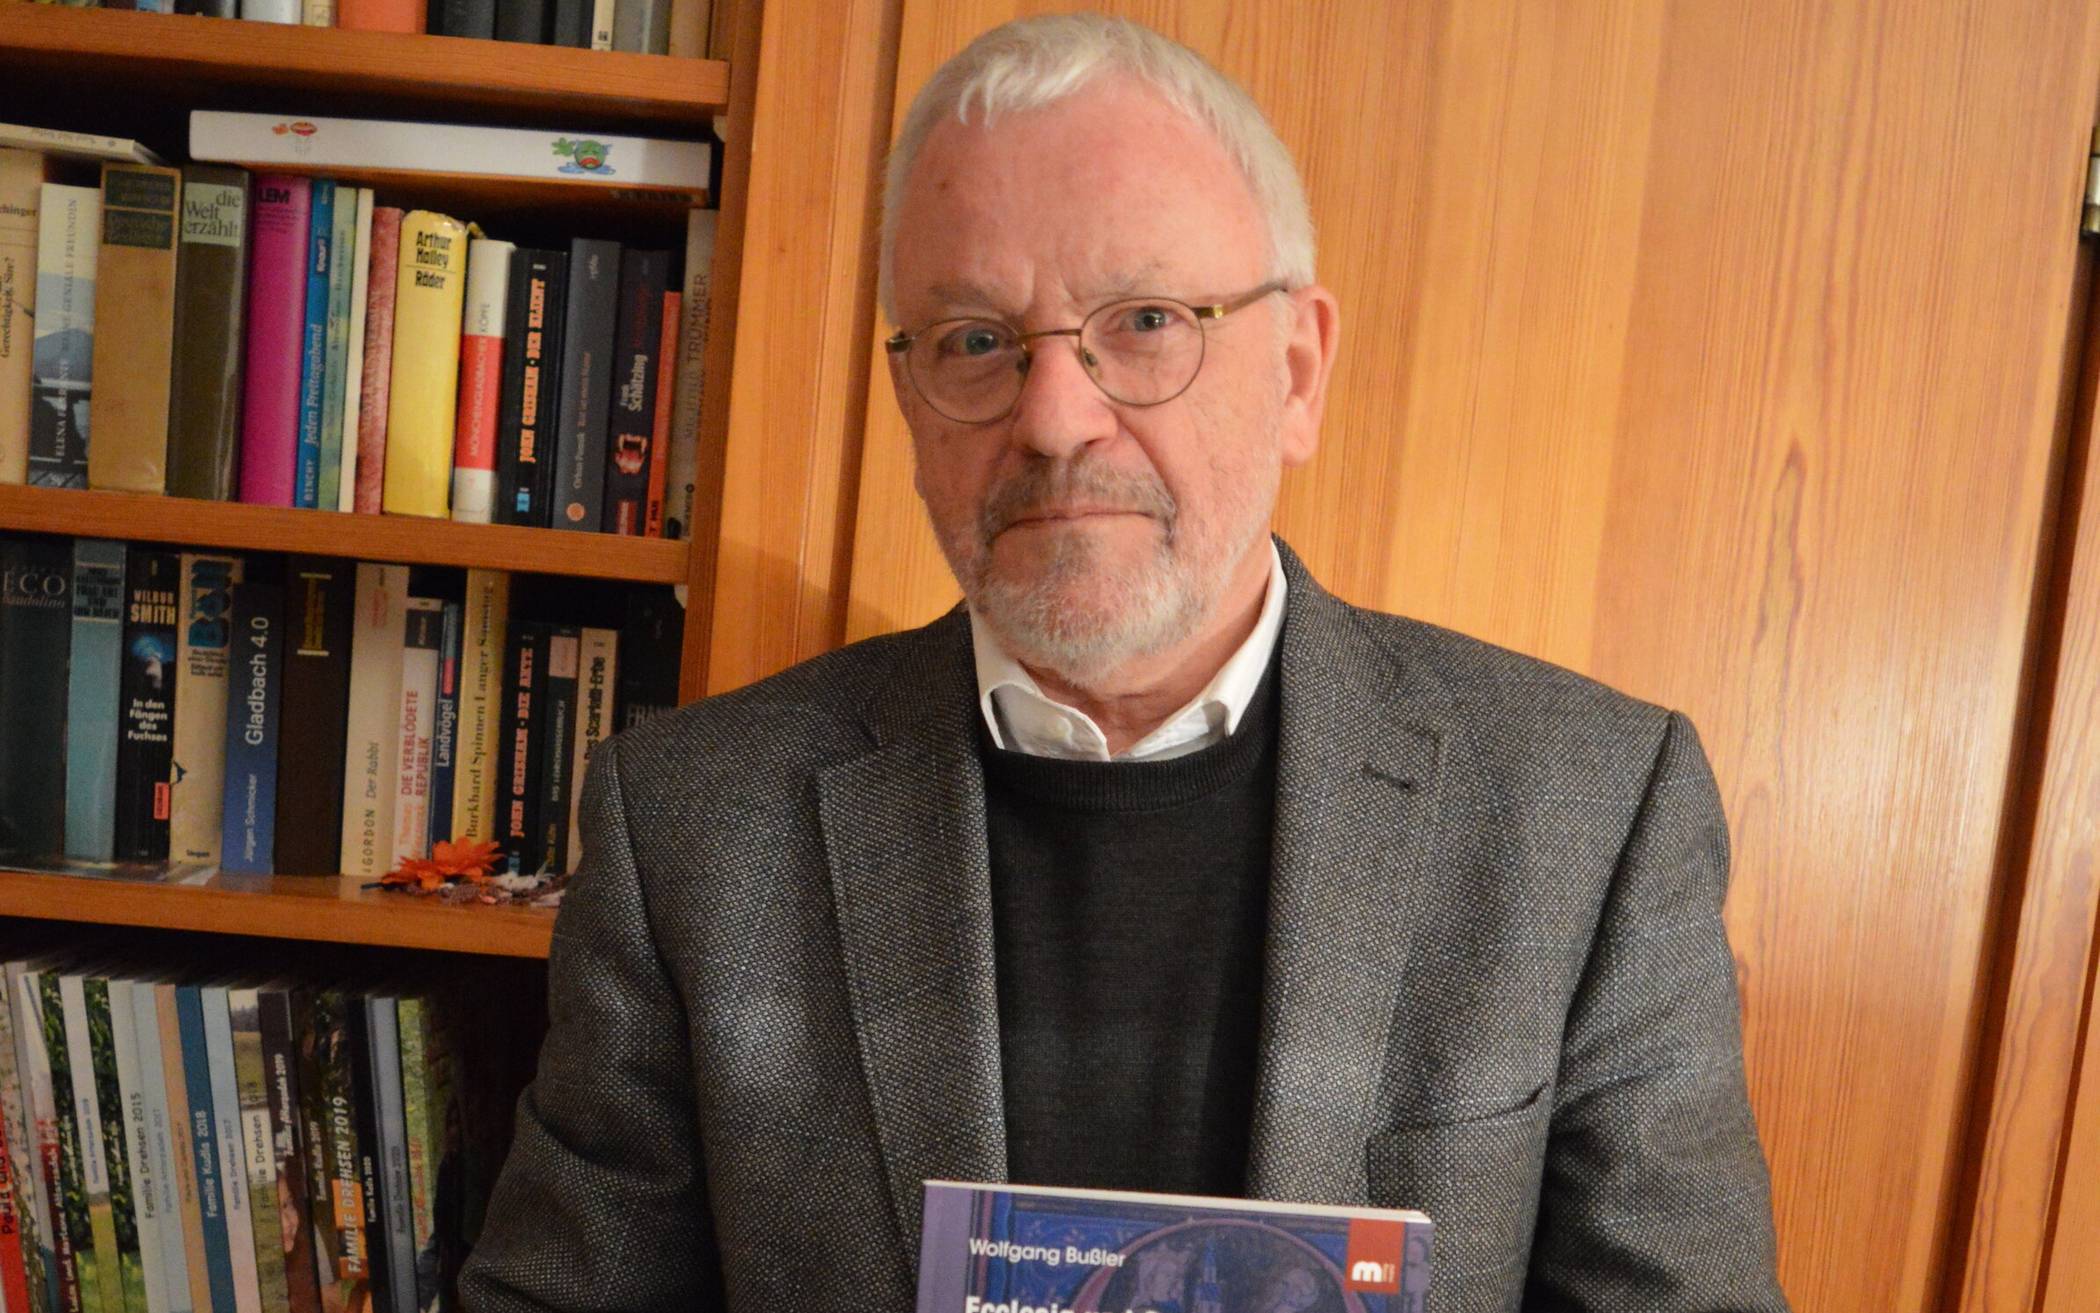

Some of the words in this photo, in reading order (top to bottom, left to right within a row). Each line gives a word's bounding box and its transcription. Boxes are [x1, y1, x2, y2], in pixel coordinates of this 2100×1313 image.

[185, 200, 220, 220] Welt
[216, 190, 241, 208] die
[258, 187, 291, 204] LEM
[416, 231, 452, 250] Arthur
[130, 603, 176, 625] SMITH
[133, 589, 175, 606] WILBUR
[250, 616, 269, 649] 4.0
[129, 709, 168, 722] Fängen
[133, 698, 144, 708] In
[145, 699, 165, 710] den
[245, 653, 267, 746] Gladbach
[139, 720, 158, 731] des
[401, 690, 418, 771] VERBLÖDETE
[435, 698, 456, 768] Landvögel
[470, 706, 487, 765] Spinnen
[401, 775, 414, 796] DIE
[415, 736, 431, 797] REPUBLIK
[465, 768, 482, 839] Burkhard
[361, 808, 376, 866] GORDON
[130, 1092, 143, 1122] 2015
[332, 1095, 349, 1136] 2019
[135, 1127, 150, 1174] Drehsen
[252, 1115, 265, 1163] Drehsen
[336, 1139, 356, 1208] DREHSEN
[141, 1178, 155, 1219] Familie
[204, 1177, 218, 1218] Familie
[342, 1213, 362, 1274] FAMILIE
[970, 1238, 1060, 1267] Wolfgang
[1066, 1243, 1126, 1268] Bußler
